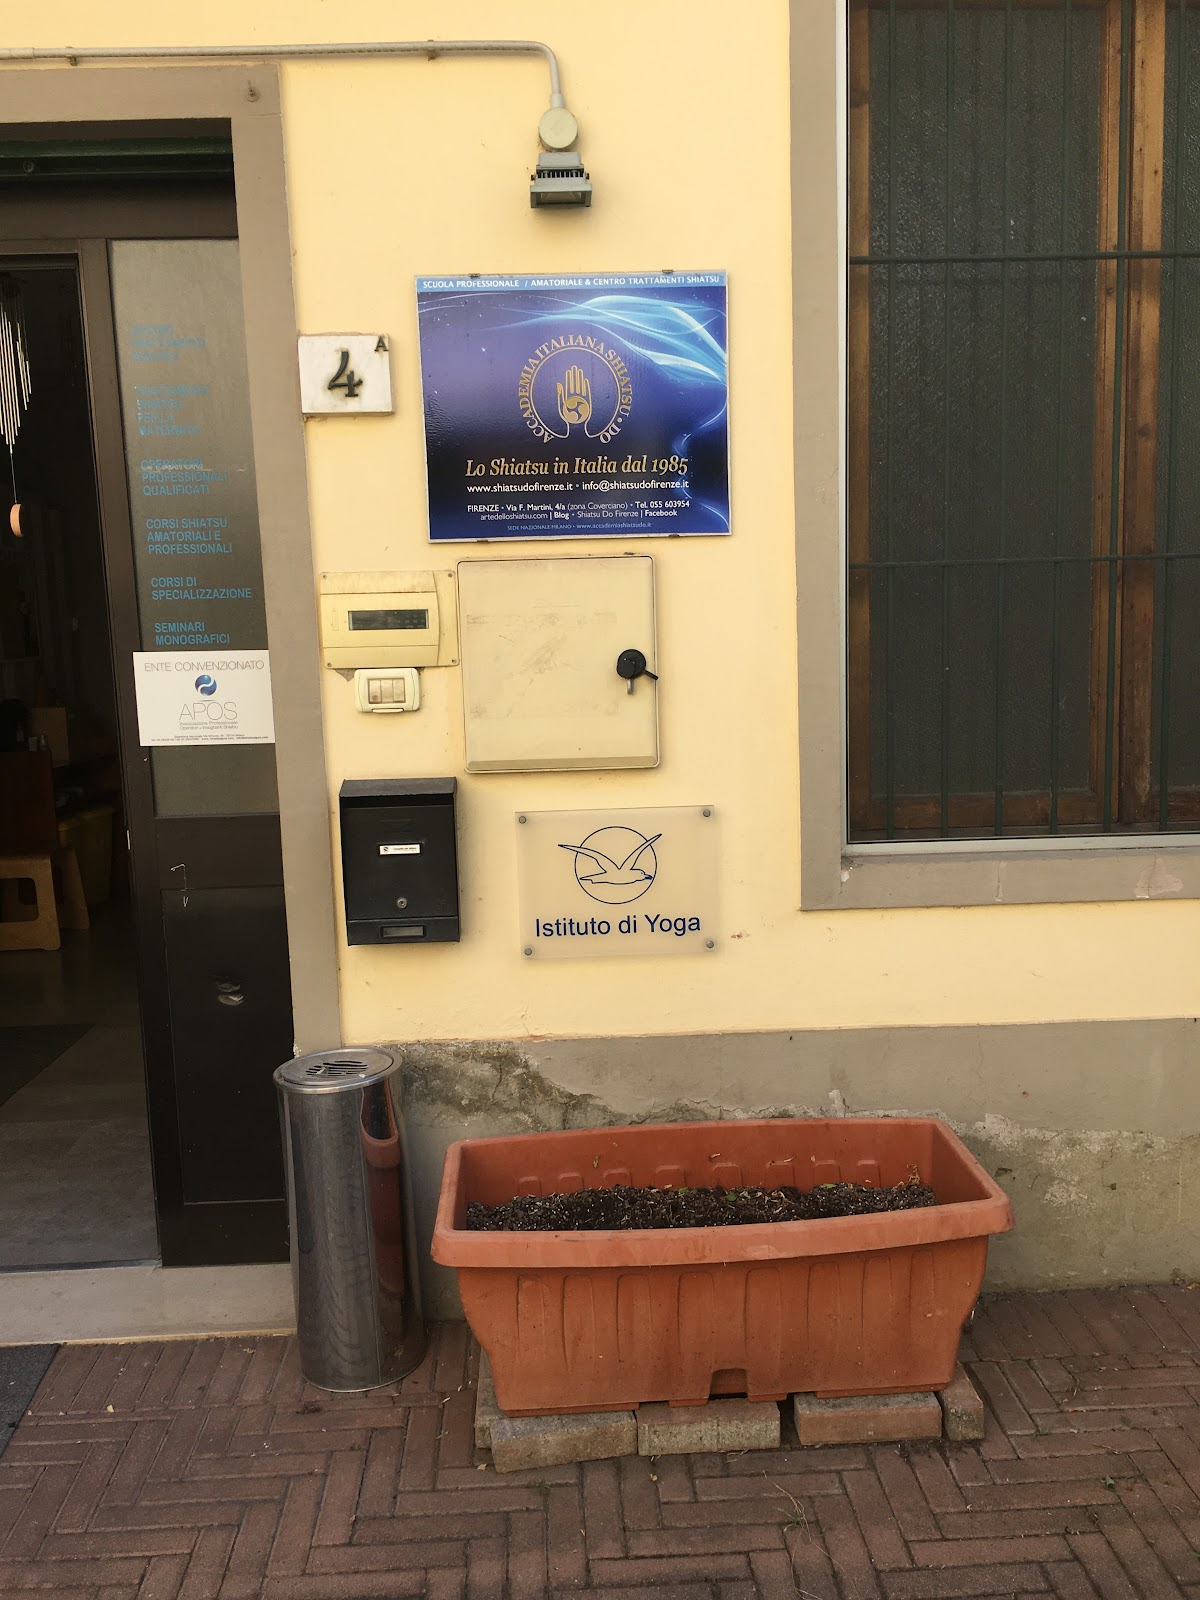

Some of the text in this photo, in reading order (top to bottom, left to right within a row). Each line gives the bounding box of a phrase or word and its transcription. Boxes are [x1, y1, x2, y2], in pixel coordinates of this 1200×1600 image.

[423, 280, 454, 289] SCUOLA
[456, 279, 519, 288] PROFESSIONALE
[530, 278, 583, 287] AMATORIALE
[585, 278, 591, 286] &
[593, 277, 626, 285] CENTRO
[629, 276, 685, 285] TRATTAMENTI
[687, 275, 720, 284] SHIATSU
[327, 335, 389, 398] 4 A
[518, 334, 633, 444] ACCADEMIA ITALIANA SHIATSU DO
[137, 412, 175, 423] PER LA
[465, 454, 689, 477] Lo Shiatsu in Italia dal 1985
[141, 471, 228, 483] PROFESSIONALI
[143, 484, 210, 496] QUALIFICATI
[466, 479, 690, 493] www.shiatsudofirenze.it info@shiatsudofirenze.it
[467, 504, 500, 513] FIRENZE
[519, 503, 526, 511] F.
[527, 503, 554, 511] Martini,
[555, 503, 566, 511] 4/a
[567, 502, 586, 511] (zona
[587, 502, 628, 511] Coverciano)
[635, 501, 648, 509] Tel.
[650, 500, 663, 508] 055
[664, 500, 690, 508] 603954
[480, 512, 548, 521] artedelloshiatsu.com
[554, 511, 570, 520] Blog
[577, 510, 601, 518] Shiatsu
[615, 509, 639, 517] Firenze
[645, 509, 678, 517] Facebook
[146, 517, 228, 529] CORSI SHIATSU
[147, 531, 221, 542] AMATORIALI E
[149, 543, 232, 555] PROFESSIONALI
[151, 577, 197, 588] CORSI DI
[151, 588, 252, 600] SPECIALIZZAZIONE
[155, 622, 205, 633] SEMINARI
[156, 634, 229, 645] MONOGRAFICI
[144, 660, 265, 672] ENTE CONVENZIONATO
[178, 701, 238, 720] APOS
[535, 913, 701, 937] Istituto di Yoga
